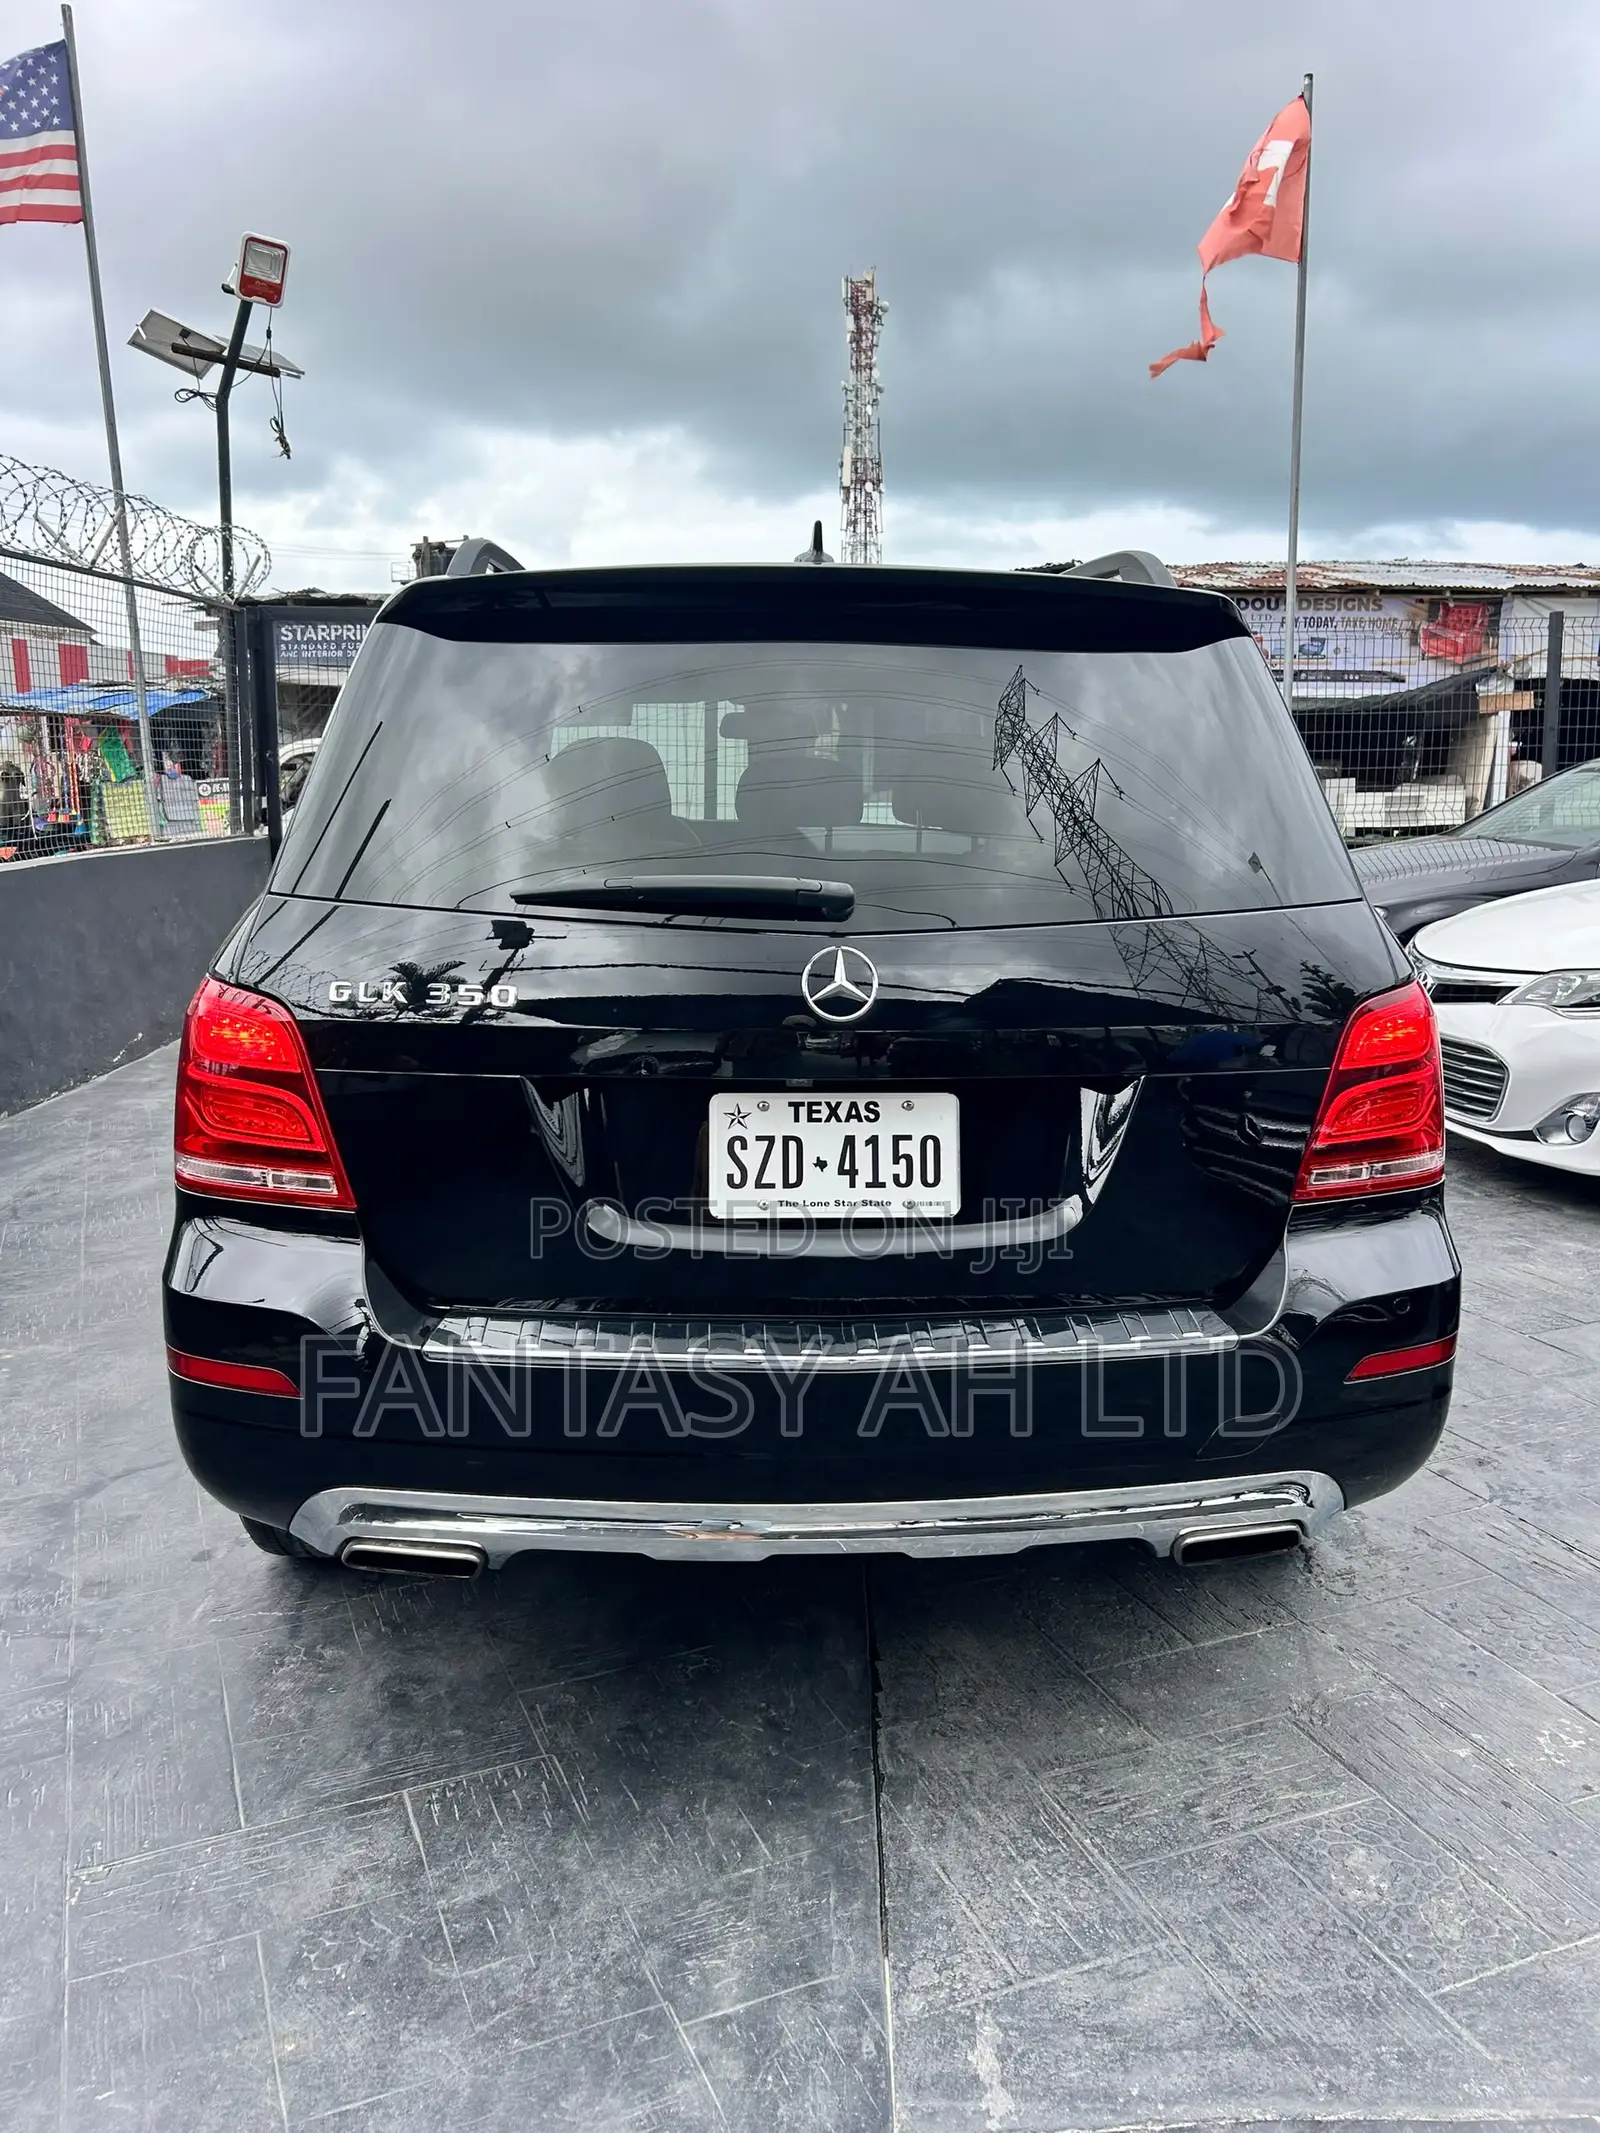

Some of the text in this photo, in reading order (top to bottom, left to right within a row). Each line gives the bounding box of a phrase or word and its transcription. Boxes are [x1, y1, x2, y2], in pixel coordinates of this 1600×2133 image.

[1298, 597, 1383, 612] DESIGNS
[1281, 616, 1299, 628] PY
[1341, 617, 1366, 629] TAKE
[280, 642, 336, 650] STANDARD
[302, 650, 343, 658] INTERIOR
[329, 981, 518, 1009] GLK 350
[788, 1101, 881, 1123] TEXAS
[726, 1134, 942, 1190] SZD 4150
[778, 1199, 892, 1207] The Lone Star State
